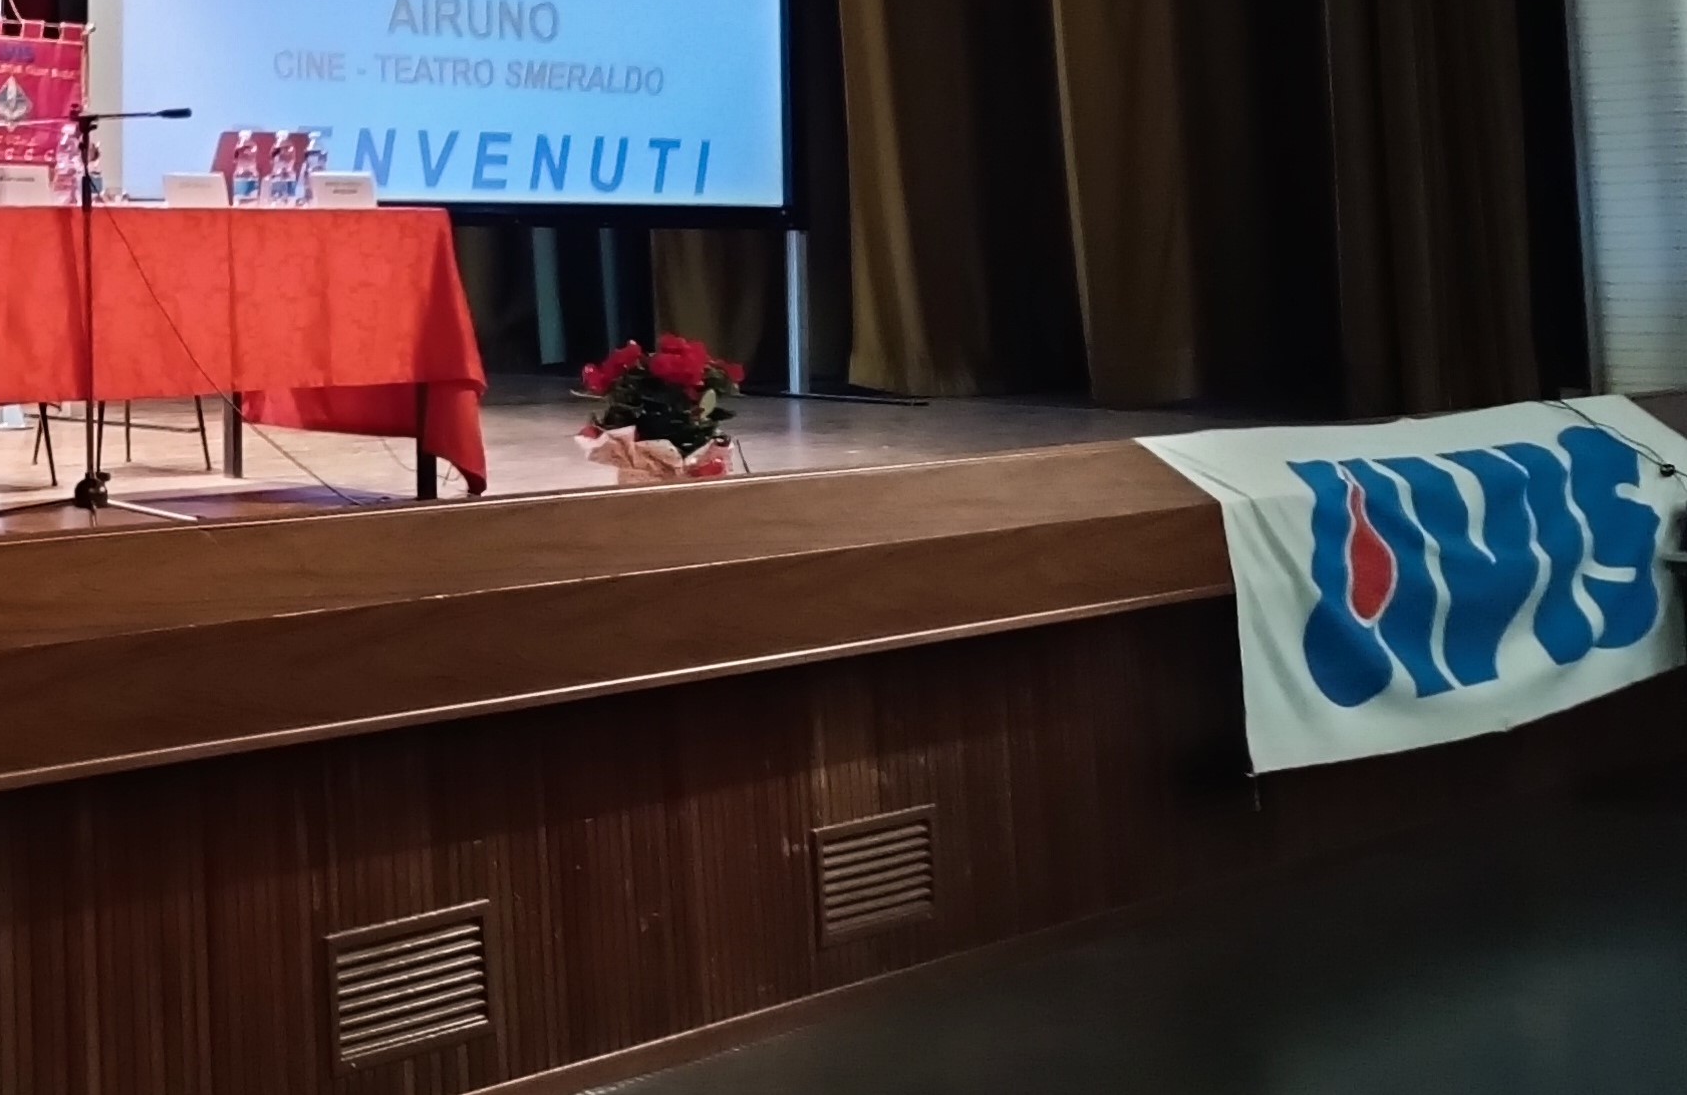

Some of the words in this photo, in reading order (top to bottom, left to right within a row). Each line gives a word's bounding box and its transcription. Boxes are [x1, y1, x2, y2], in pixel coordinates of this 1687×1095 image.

[273, 50, 346, 81] CINE
[374, 53, 494, 89] TEATRO
[505, 60, 665, 97] SMERALDO
[232, 124, 711, 195] NVENUTI
[1286, 425, 1660, 707] AVIS
